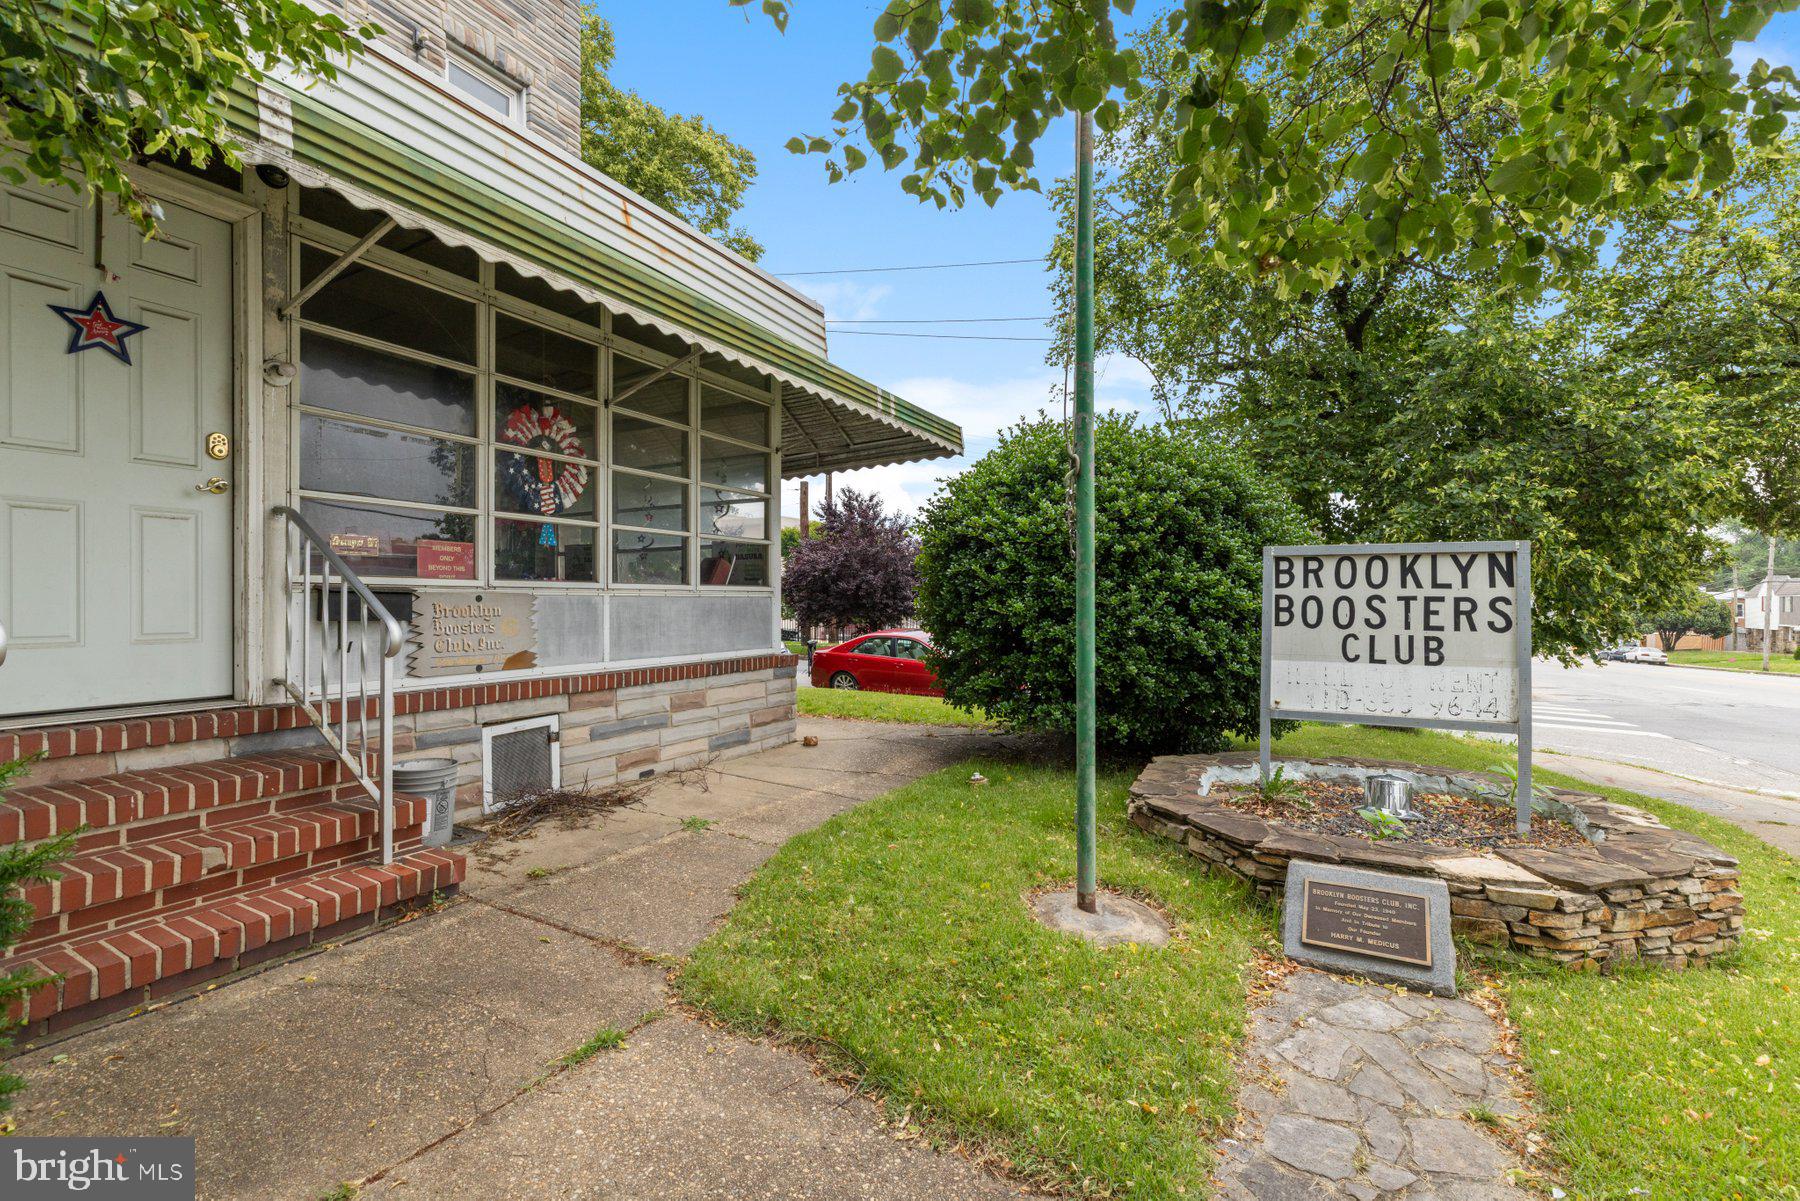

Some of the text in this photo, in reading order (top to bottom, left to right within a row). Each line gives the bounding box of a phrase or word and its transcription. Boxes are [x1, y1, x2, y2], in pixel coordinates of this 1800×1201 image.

[1274, 552, 1515, 590] BROOKLYN
[432, 600, 501, 621] Brooklyn
[1274, 594, 1514, 633] BOOSTERS
[432, 617, 496, 636] Boosters
[1341, 633, 1445, 666] CLUB
[1312, 888, 1344, 898] BROOKLYN
[1347, 894, 1380, 904] BOOSTERS
[1405, 902, 1420, 910] INC.
[1322, 906, 1342, 914] Memory
[1392, 918, 1416, 926] Members
[1330, 932, 1354, 940] HARRY
[1368, 938, 1400, 950] MEDICUS
